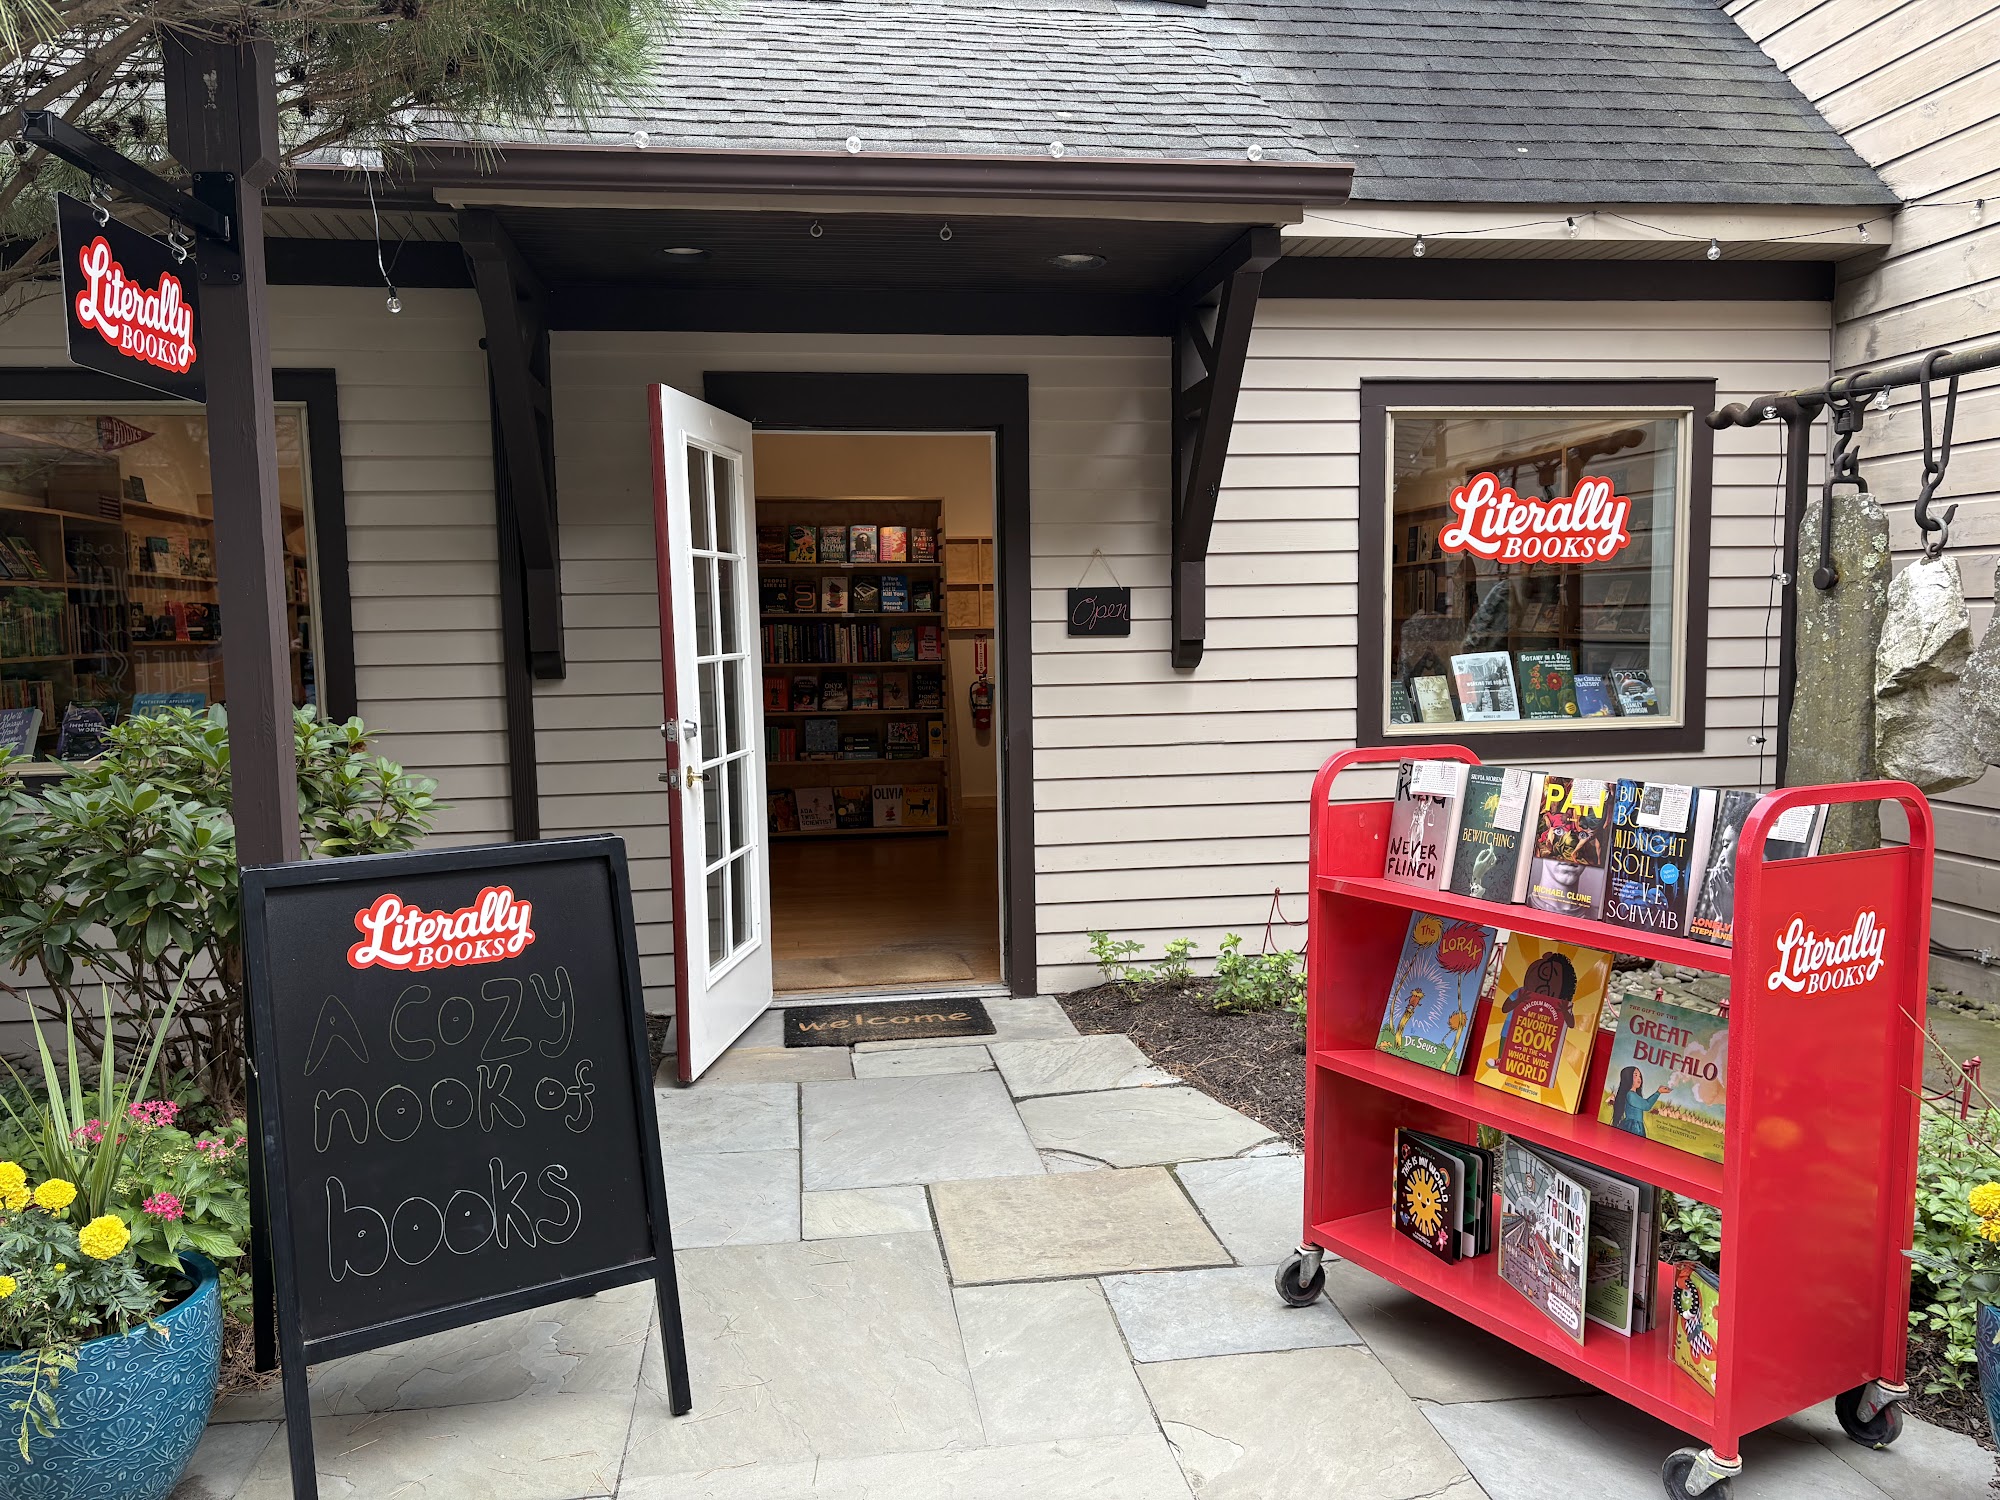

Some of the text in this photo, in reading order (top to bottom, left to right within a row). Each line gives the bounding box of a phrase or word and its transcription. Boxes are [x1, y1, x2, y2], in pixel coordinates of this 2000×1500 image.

[79, 245, 194, 367] Literally
[121, 323, 178, 366] BOOKS
[112, 419, 142, 446] BOOKS
[1444, 478, 1627, 555] Literally
[1502, 537, 1597, 559] BOOKS
[1072, 595, 1129, 630] Open
[1521, 654, 1543, 662] BOTANY
[873, 788, 904, 800] OLIVIA
[1545, 783, 1606, 819] PAN
[1390, 836, 1438, 861] NEVER
[1463, 828, 1516, 849] BEWITCHING
[1613, 829, 1687, 858] MIDNIGHT
[1387, 857, 1436, 881] FLINCH
[1611, 851, 1654, 879] SOIL
[1533, 885, 1566, 898] MICHAEL
[1566, 891, 1592, 904] CLUNE
[355, 889, 533, 964] Literally
[1606, 899, 1679, 930] SCHWAB
[1693, 917, 1732, 932] LONELY
[1421, 924, 1436, 937] The
[416, 937, 505, 967] BOOKS
[1442, 936, 1482, 960] LORAX
[1768, 910, 1886, 993] Literally
[1806, 966, 1867, 995] BOOKS
[798, 1011, 972, 1032] welcome
[1522, 1000, 1559, 1021] MALCOLM MITCHELL
[1527, 1011, 1551, 1023] MY VERY
[1629, 1004, 1641, 1012] THE
[1641, 1007, 1656, 1015] GIFT
[1666, 1013, 1679, 1021] THE
[305, 995, 369, 1076] A
[1512, 1025, 1556, 1054] BOOK
[1516, 1015, 1559, 1037] FAVORITE
[1629, 1014, 1694, 1049] GREAT
[1404, 1035, 1438, 1055] Dr. Seuss
[1528, 1048, 1539, 1057] THE
[1505, 1058, 1548, 1083] WORLD
[1508, 1049, 1551, 1070] WHOLE WIDE
[1633, 1039, 1718, 1081] BUFFALO
[535, 1059, 596, 1134] of
[1401, 1155, 1449, 1203] THIS IS MY WORLD
[1557, 1178, 1580, 1211] HOW
[326, 1157, 582, 1282] books
[1547, 1195, 1581, 1236] TRAINS
[1552, 1222, 1582, 1261] WORK
